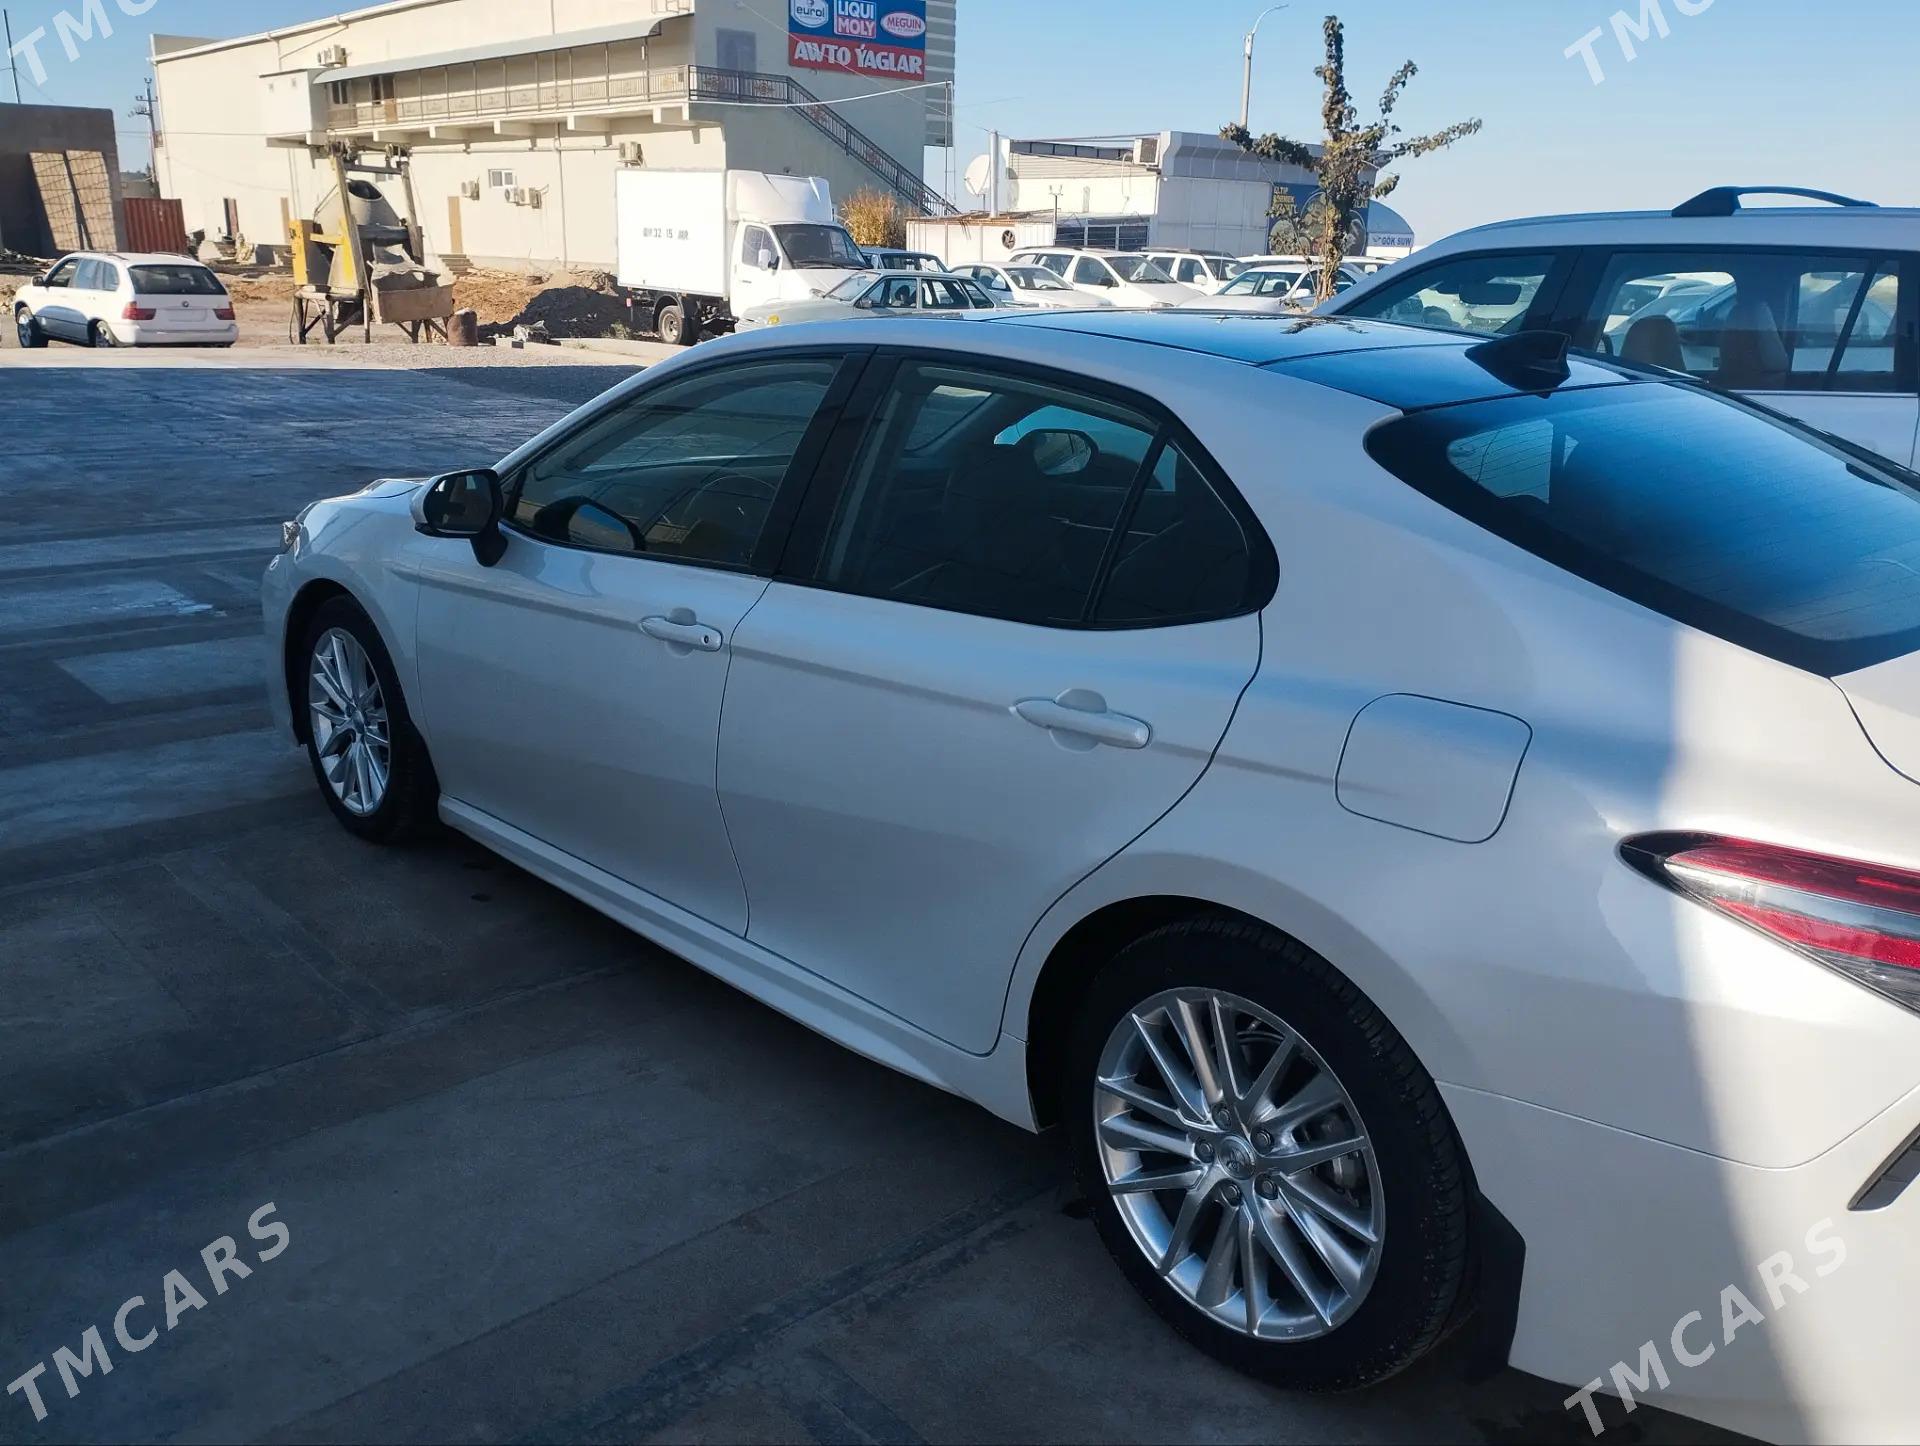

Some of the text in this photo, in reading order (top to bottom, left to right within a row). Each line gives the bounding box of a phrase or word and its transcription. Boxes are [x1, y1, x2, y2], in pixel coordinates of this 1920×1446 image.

[796, 5, 825, 18] eurol
[838, 0, 874, 19] LIQUI
[838, 17, 875, 36] MOLY
[886, 17, 922, 30] MEGUIN
[794, 41, 923, 74] AWTO ÝAGLAR
